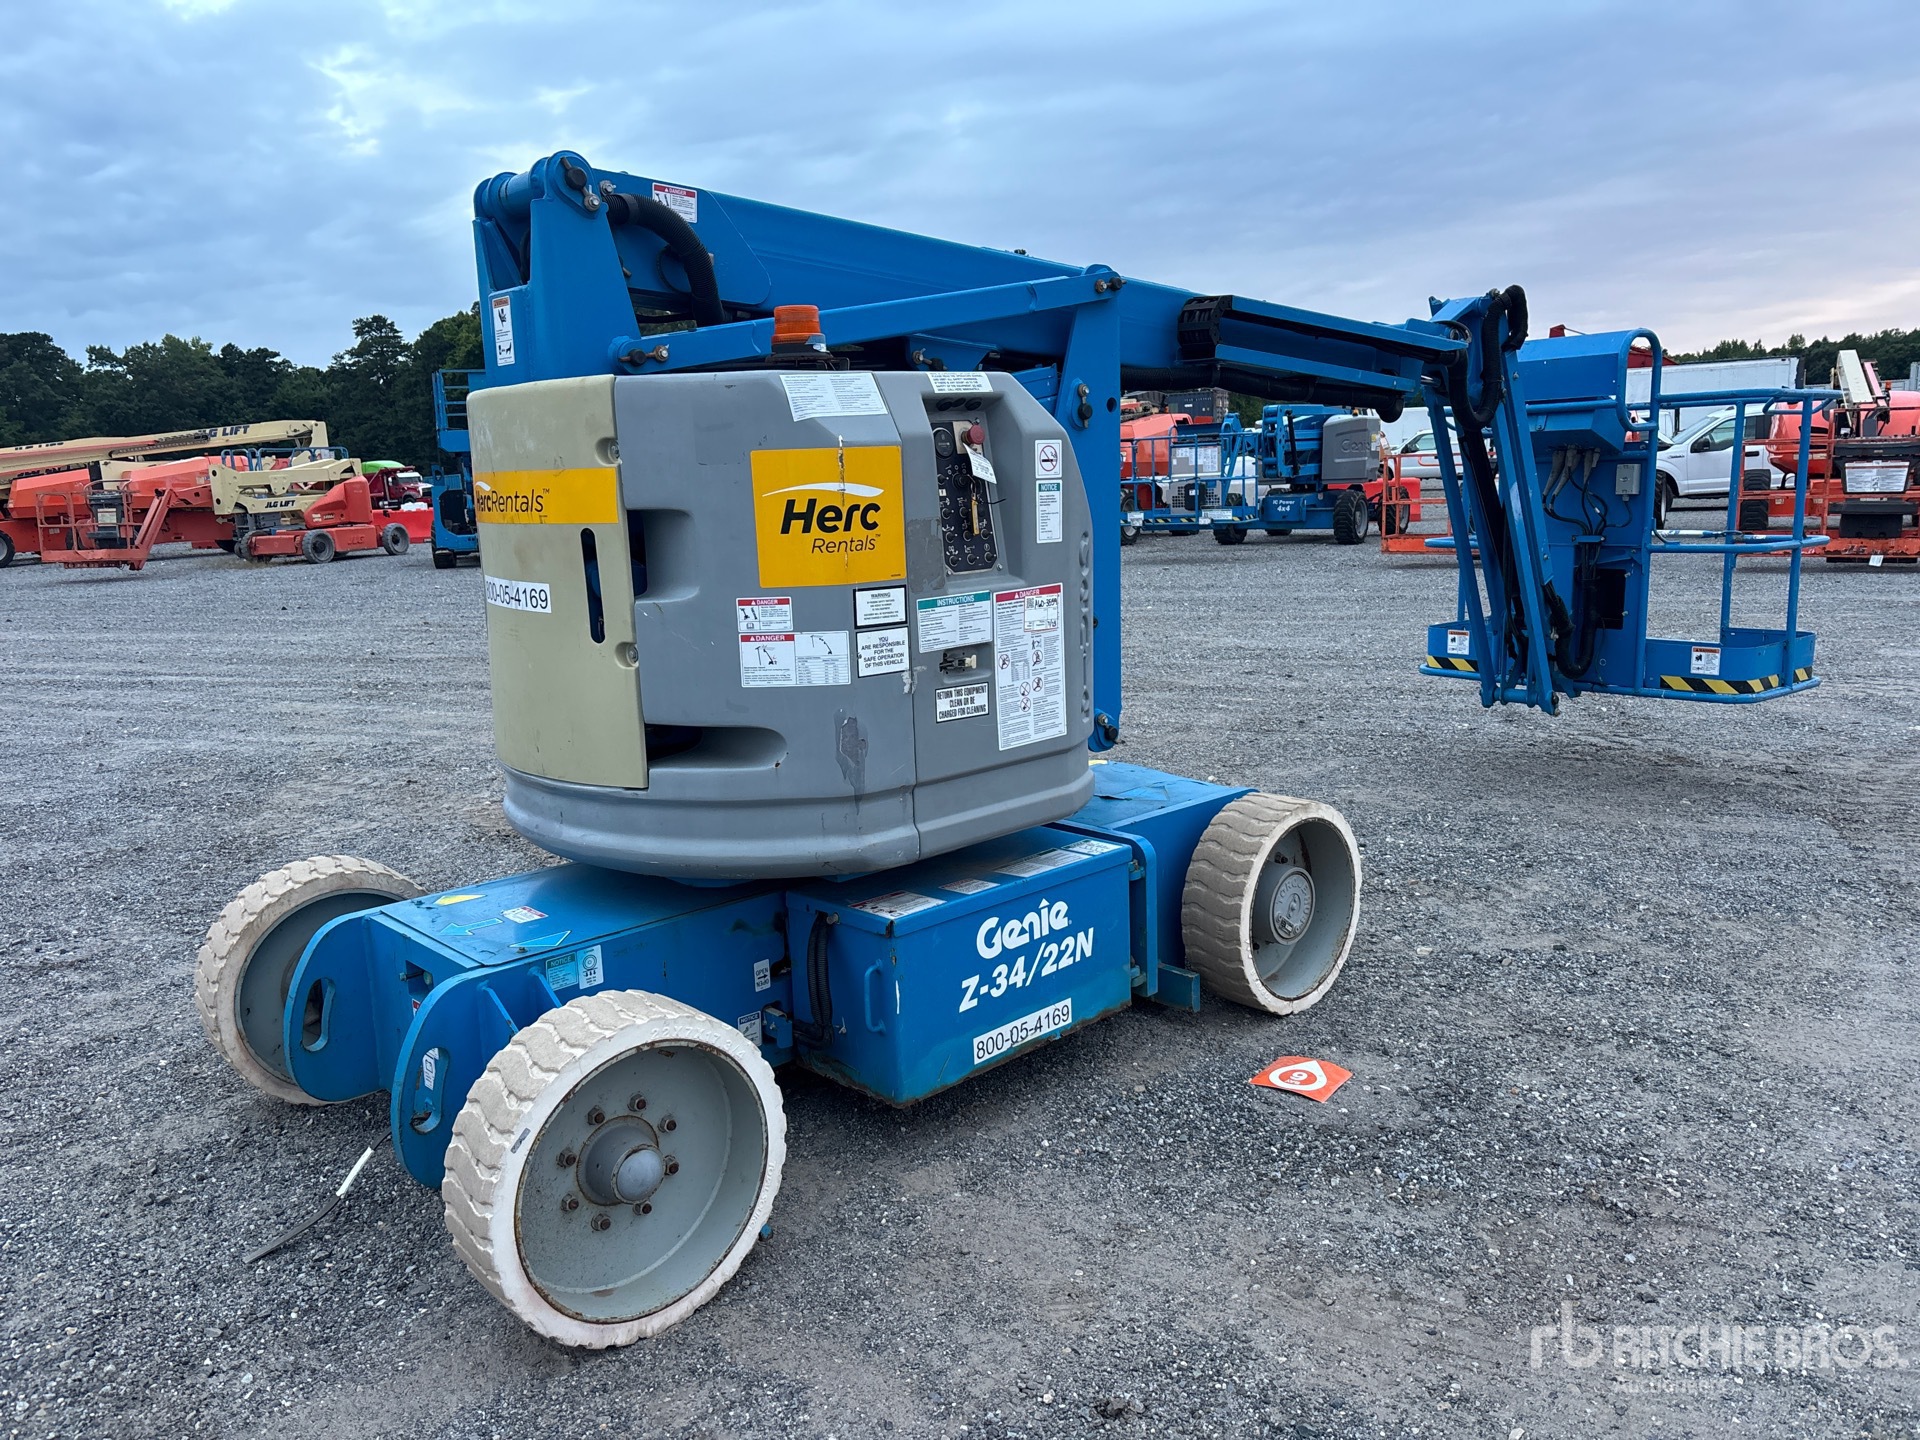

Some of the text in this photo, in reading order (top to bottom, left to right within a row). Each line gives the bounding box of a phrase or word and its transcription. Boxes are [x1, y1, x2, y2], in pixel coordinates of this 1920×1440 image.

[669, 187, 687, 196] DANGER
[222, 425, 250, 437] LIFT
[1040, 483, 1058, 491] NOTICE
[265, 500, 296, 509] JLG LIFT
[780, 498, 881, 535] Herc
[937, 595, 975, 607] INSTRUCTIONS
[872, 640, 906, 649] RESPONSIBLE
[877, 652, 905, 661] OPERATION
[954, 688, 964, 698] THIS
[964, 685, 987, 697] EQUIPMENT
[950, 699, 963, 708] CLEAN
[970, 696, 976, 705] BE
[939, 704, 987, 720] CHARGED FOR CLEANING
[976, 898, 1070, 960] Genie
[551, 956, 572, 967] NOTICE
[755, 967, 769, 977] OPEN
[958, 927, 1094, 1014] Z-34/22N
[740, 1014, 759, 1024] NOTICE
[976, 1004, 1070, 1060] 800-05-4169
